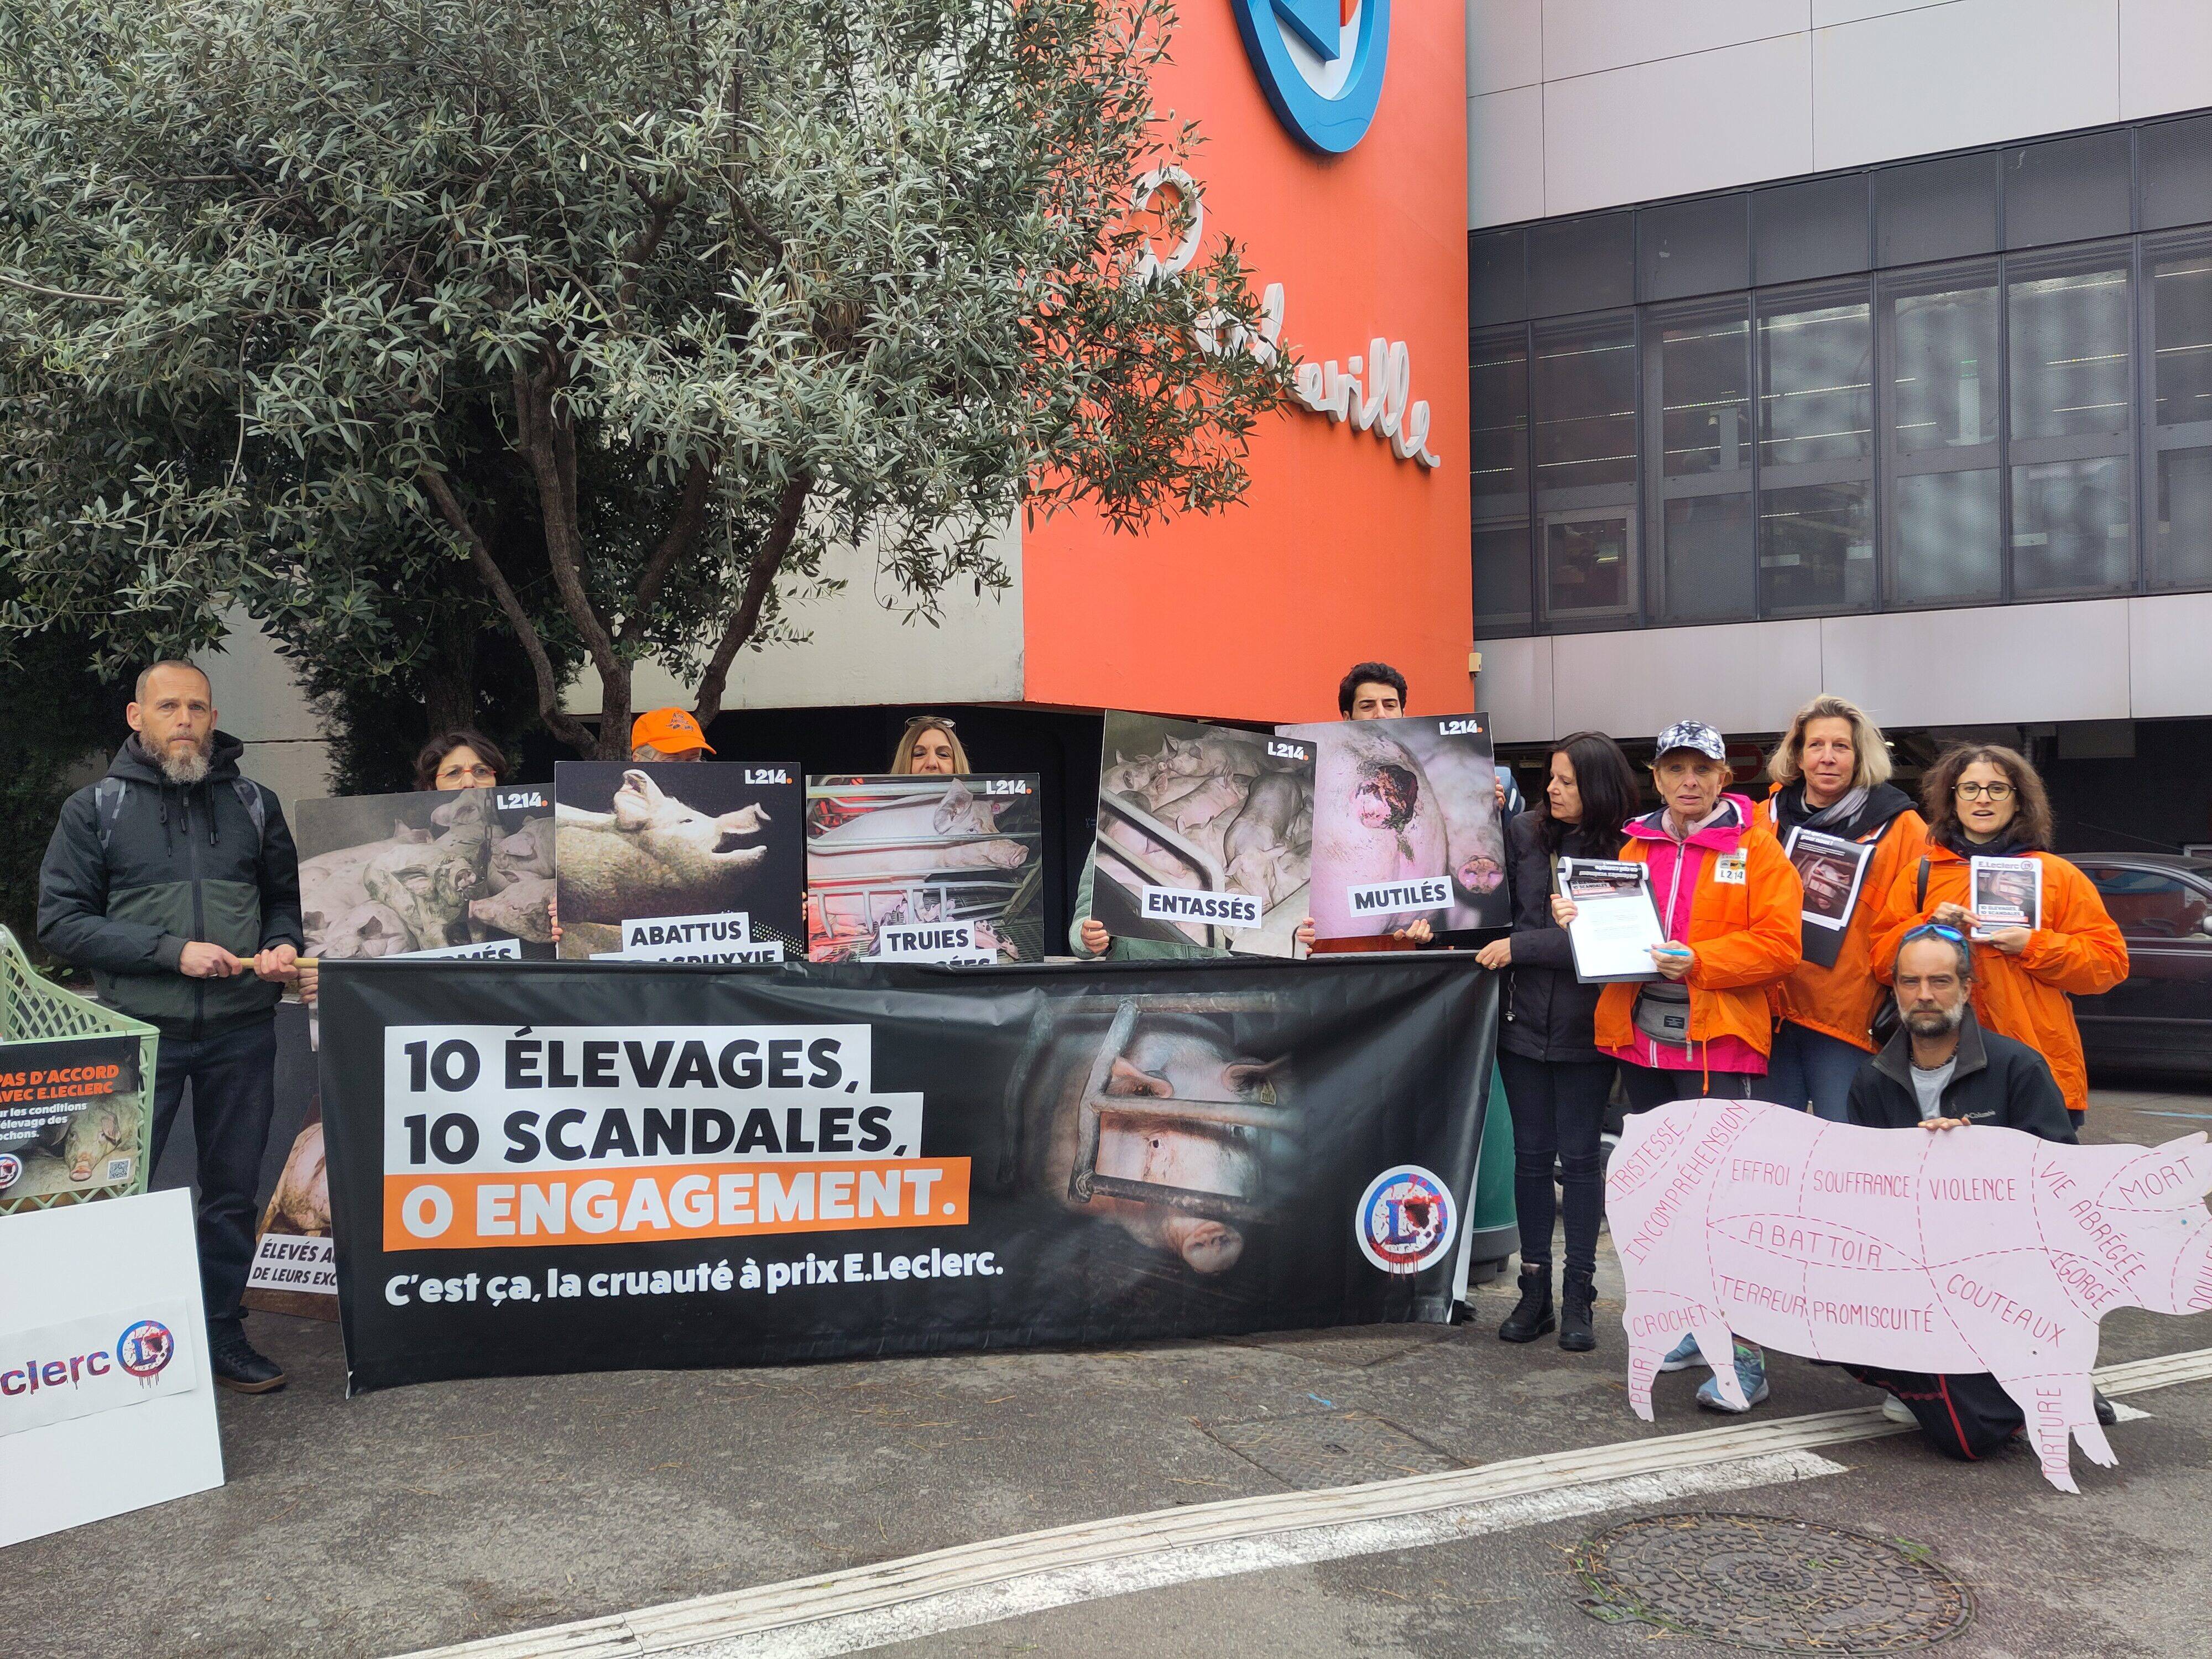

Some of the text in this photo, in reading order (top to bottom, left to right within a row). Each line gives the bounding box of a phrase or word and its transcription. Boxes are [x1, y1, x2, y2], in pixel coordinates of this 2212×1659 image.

[1149, 894, 1256, 921] ENTASSÉS
[1354, 880, 1447, 910] MUTILÉS
[630, 921, 742, 946] ABATTUS
[886, 928, 968, 951] TRUIES
[30, 1065, 119, 1085] D'ACCORD
[405, 1026, 860, 1094] 10 ÉLEVAGES,
[37, 1081, 113, 1100] E.LECLERC
[10, 1108, 27, 1117] les
[28, 1103, 87, 1115] conditions
[47, 1115, 68, 1124] des
[405, 1106, 907, 1165] 10 SCANDALES,
[1607, 1117, 1683, 1193] TRISTESSE
[1623, 1100, 1749, 1265] INCOMPRÉHENSION
[1731, 1159, 1790, 1186] EFFROI
[1814, 1170, 1910, 1197] SOUFFRANCE
[2119, 1156, 2193, 1205] MORT
[476, 1168, 956, 1236] ENGAGEMENT.
[1929, 1178, 2016, 1201] VIOLENCE
[2041, 1161, 2146, 1282] VIE ABRÉGÉE
[260, 1239, 335, 1263] ÉLEVÉS A
[1748, 1222, 1882, 1267] ABATTOIR
[252, 1267, 271, 1280] DE
[271, 1268, 311, 1284] LEURS
[385, 1248, 1004, 1307] C'est ça, la cruauté à prix E.Leclerc.
[1719, 1275, 1806, 1318] TERREUR
[1947, 1273, 2065, 1348] COUTEAUX
[1634, 1303, 1707, 1337] CROCHET
[1814, 1302, 1933, 1332] PROMISCUITÉ
[1630, 1357, 1653, 1404] PEUR
[2037, 1388, 2068, 1477] TORTURE
